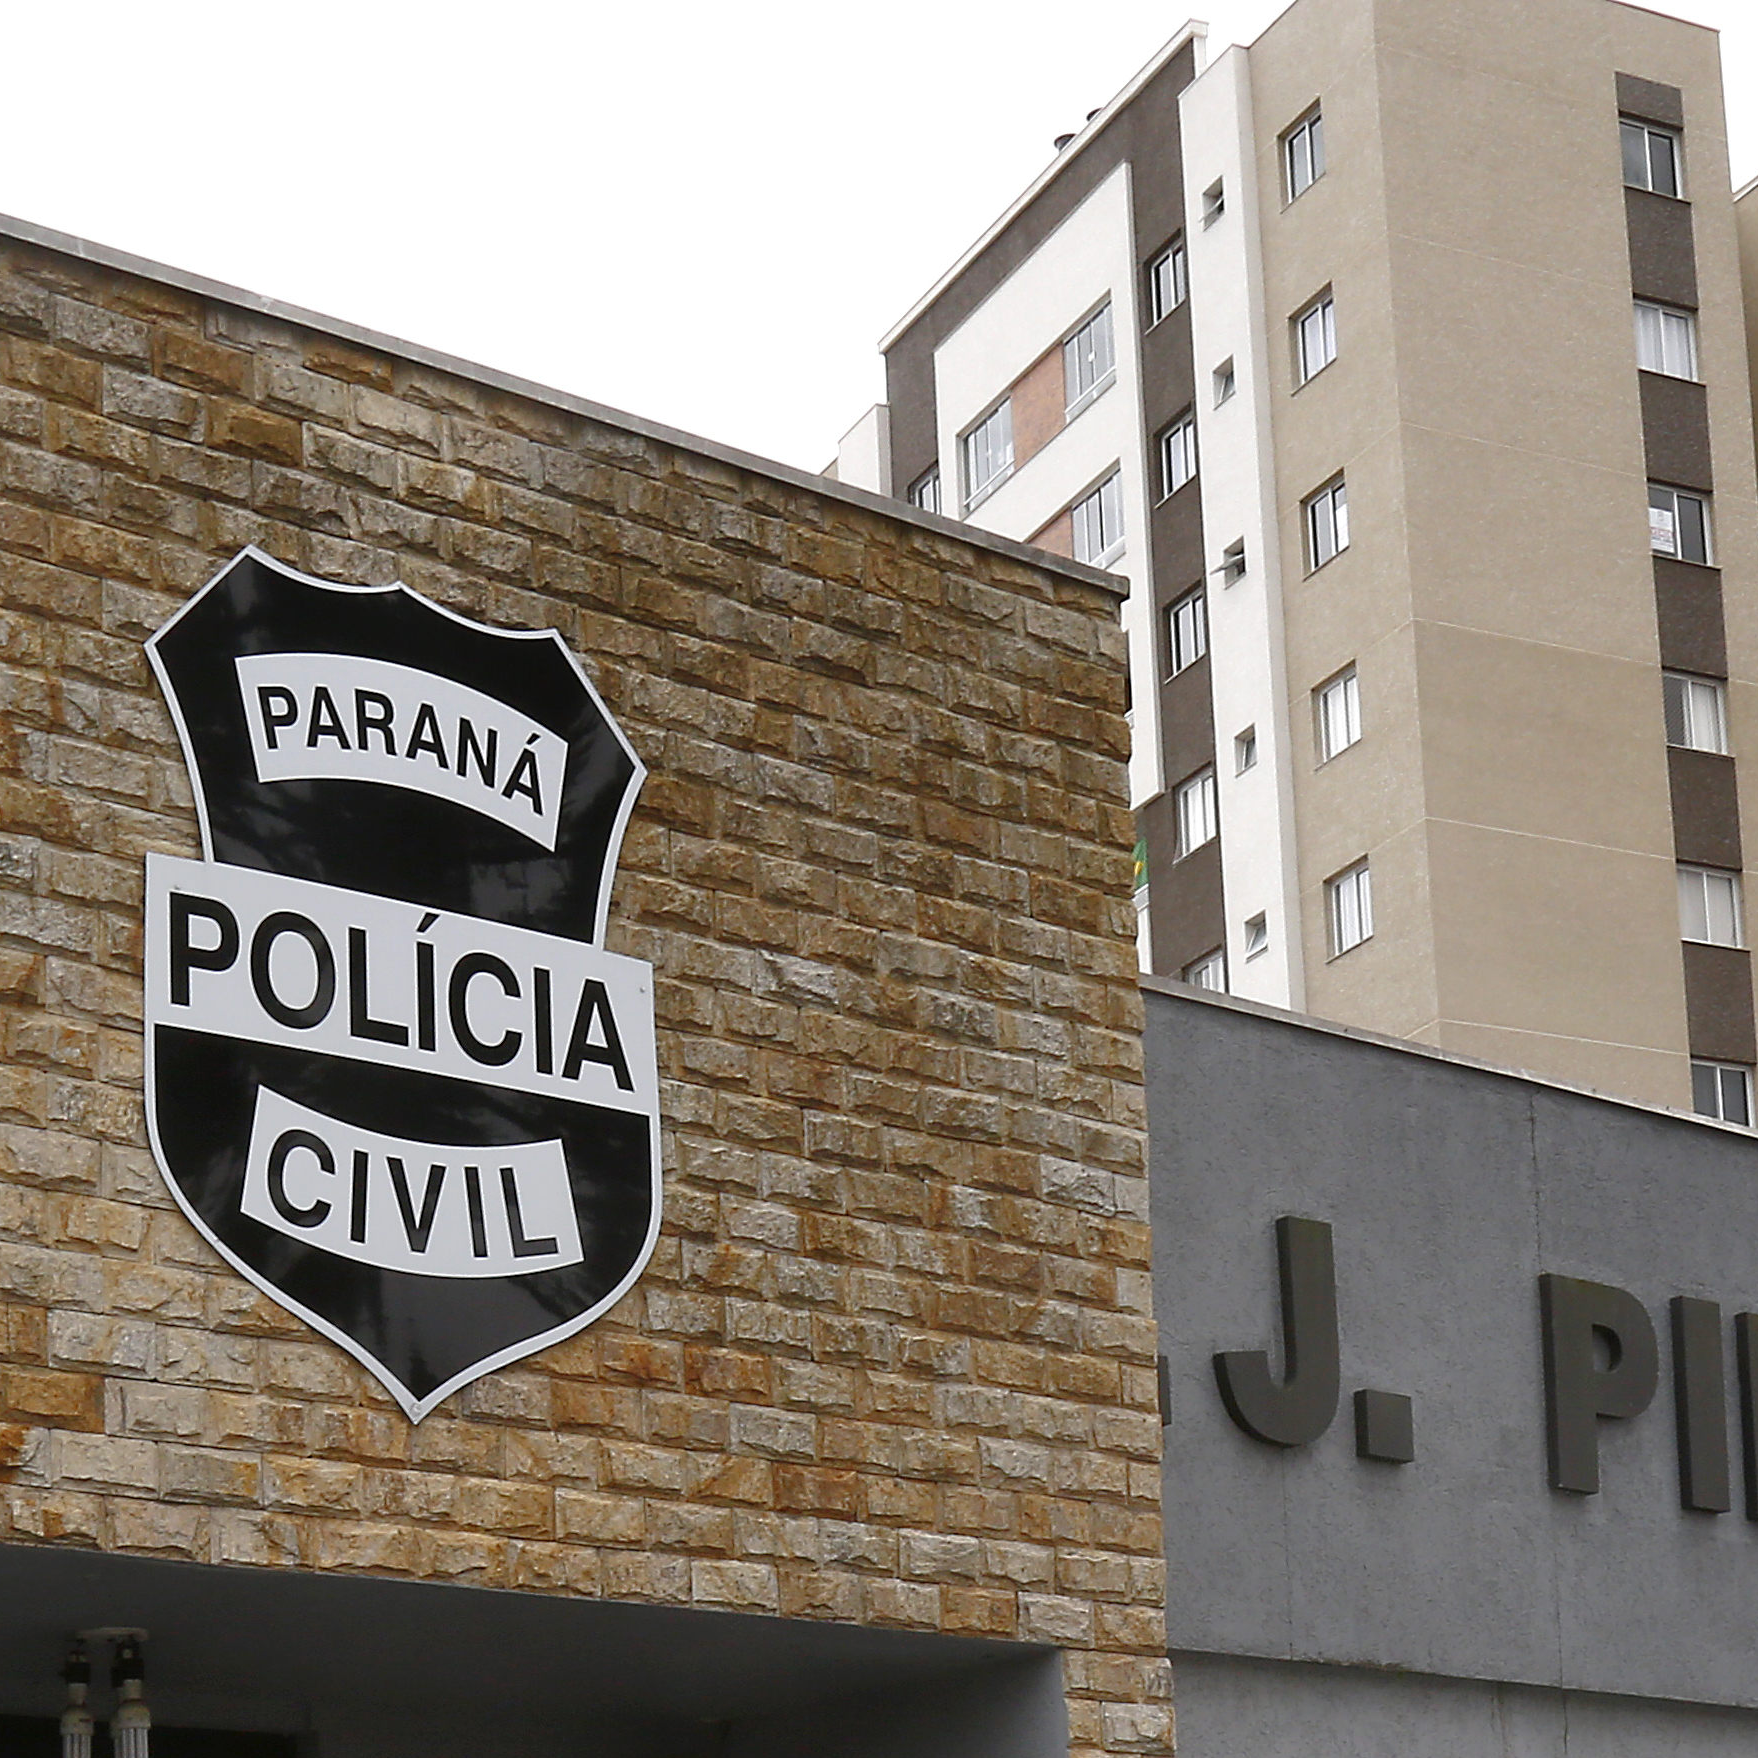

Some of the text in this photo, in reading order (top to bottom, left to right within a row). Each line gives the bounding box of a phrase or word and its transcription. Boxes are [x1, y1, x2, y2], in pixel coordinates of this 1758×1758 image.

[256, 685, 546, 816] PARANÁ
[168, 891, 636, 1093] POLÍCIA
[265, 1127, 560, 1260] CIVIL
[1212, 1214, 1416, 1464] J.
